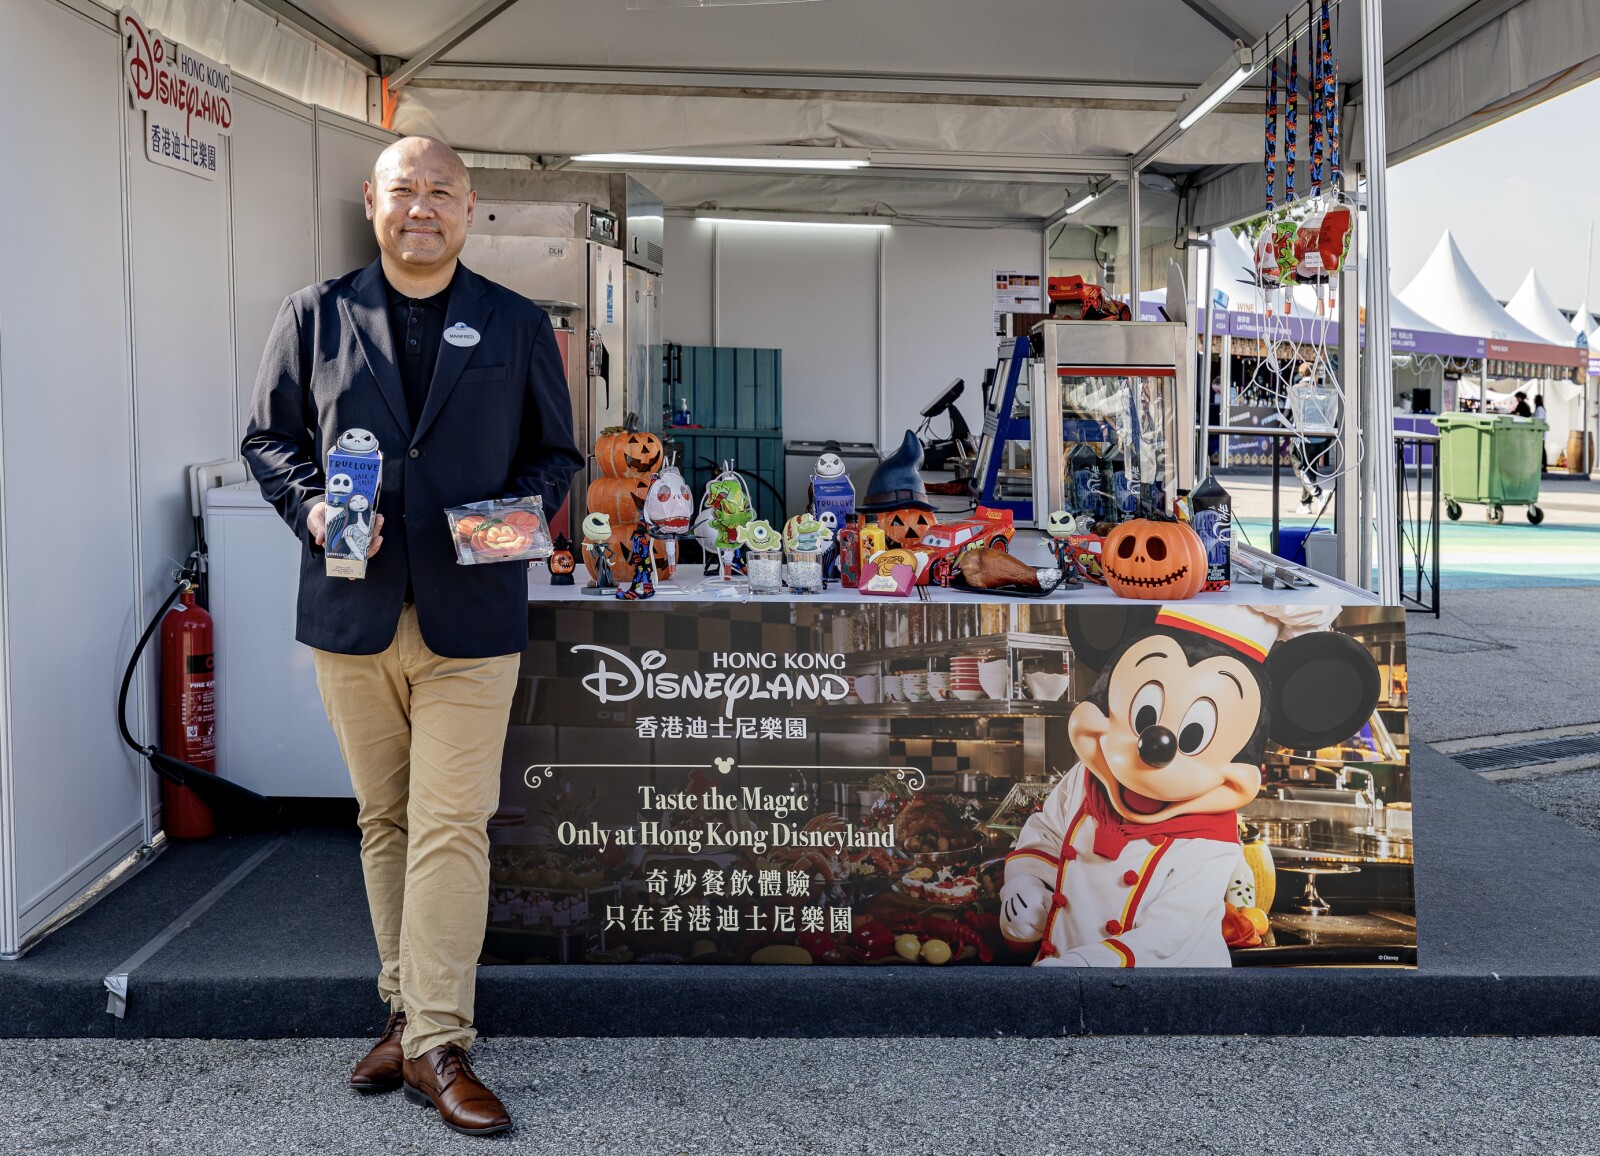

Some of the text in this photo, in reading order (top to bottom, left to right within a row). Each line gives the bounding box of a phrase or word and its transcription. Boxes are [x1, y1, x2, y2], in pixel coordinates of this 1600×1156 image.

[182, 53, 230, 94] HONG KONG
[151, 124, 216, 172] 香港迪士尼樂園
[1237, 302, 1254, 313] WINE
[712, 652, 846, 669] HONG KONG
[635, 716, 807, 740] 香港迪士尼樂園
[638, 786, 808, 818] Taste the Magic
[557, 821, 895, 855] Only at Hong Kong Disneyland
[645, 868, 811, 898] 奇妙餐飲體驗
[604, 904, 853, 933] 只在香港迪士尼樂園
